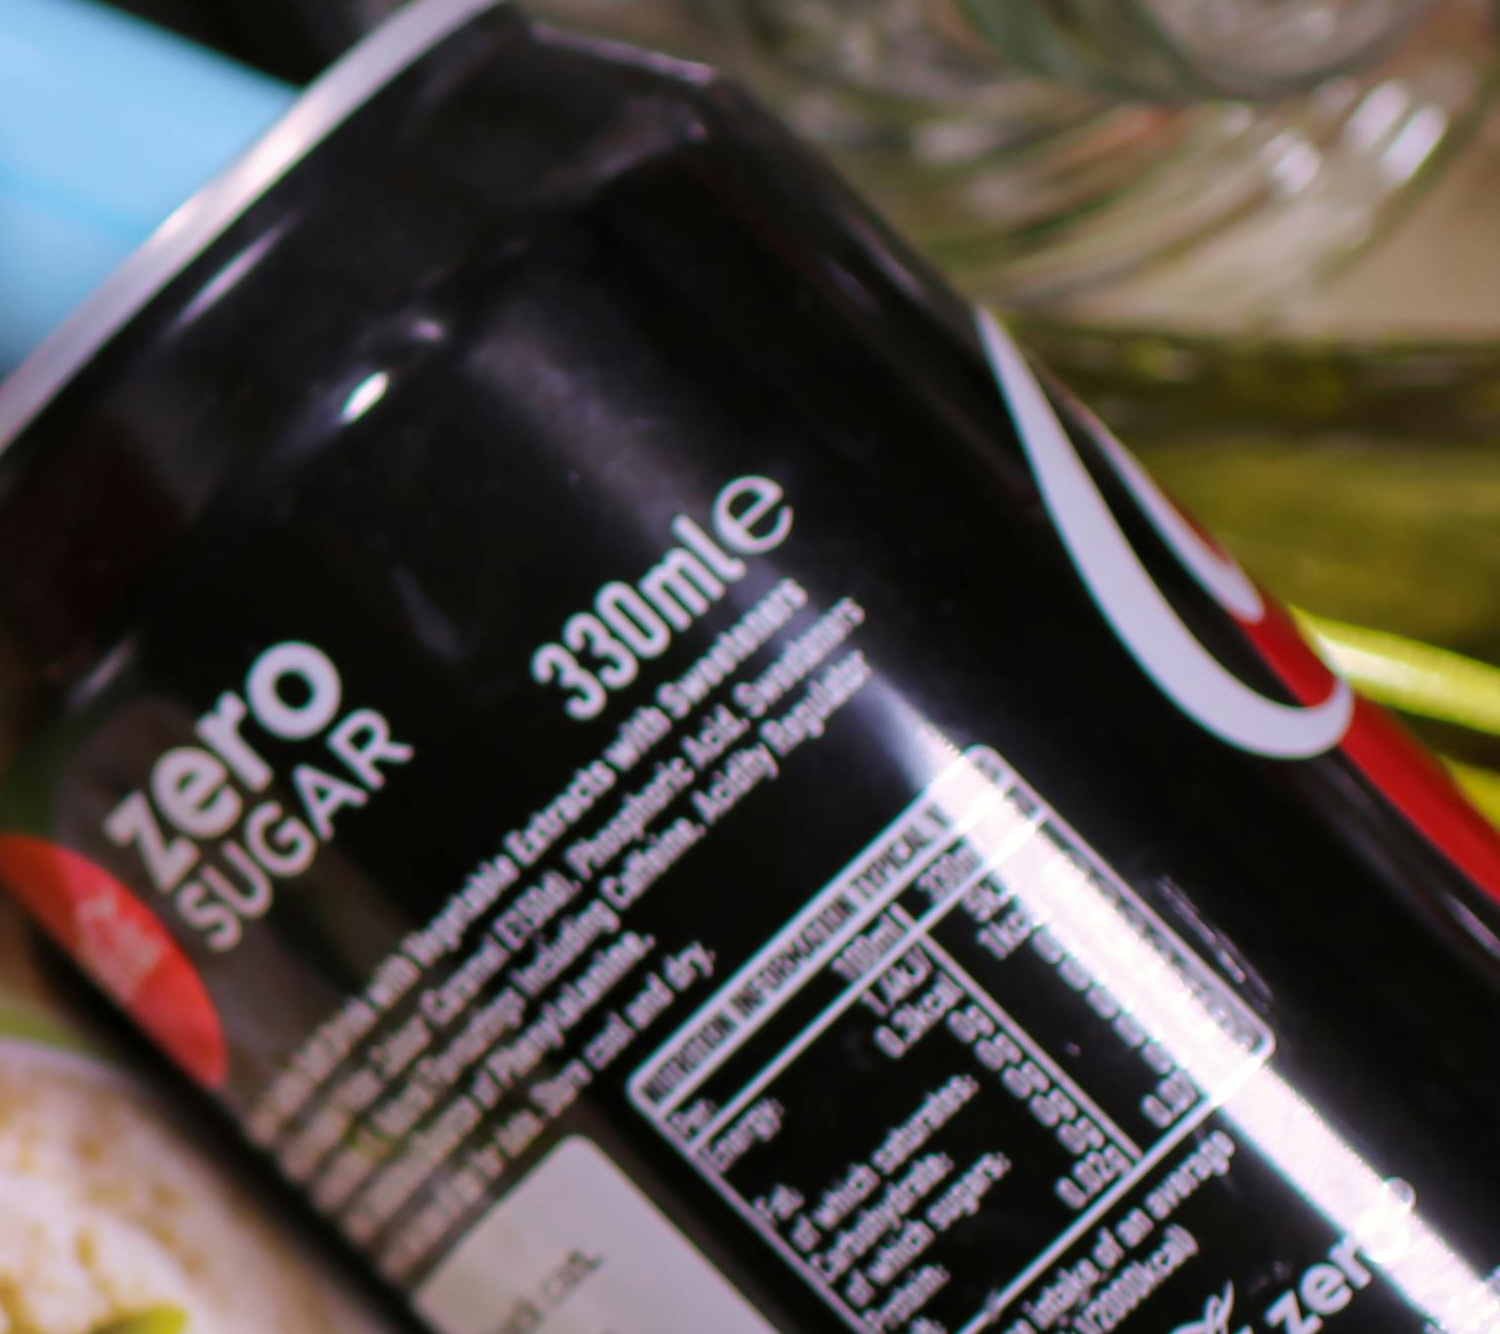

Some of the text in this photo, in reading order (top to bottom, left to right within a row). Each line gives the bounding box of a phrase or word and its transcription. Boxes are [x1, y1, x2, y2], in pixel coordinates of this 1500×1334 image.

[530, 513, 746, 721] 330ml
[659, 576, 808, 725] Sweeteners
[104, 640, 345, 895] zero
[177, 706, 415, 951] SUGAR
[914, 838, 986, 905] 330m
